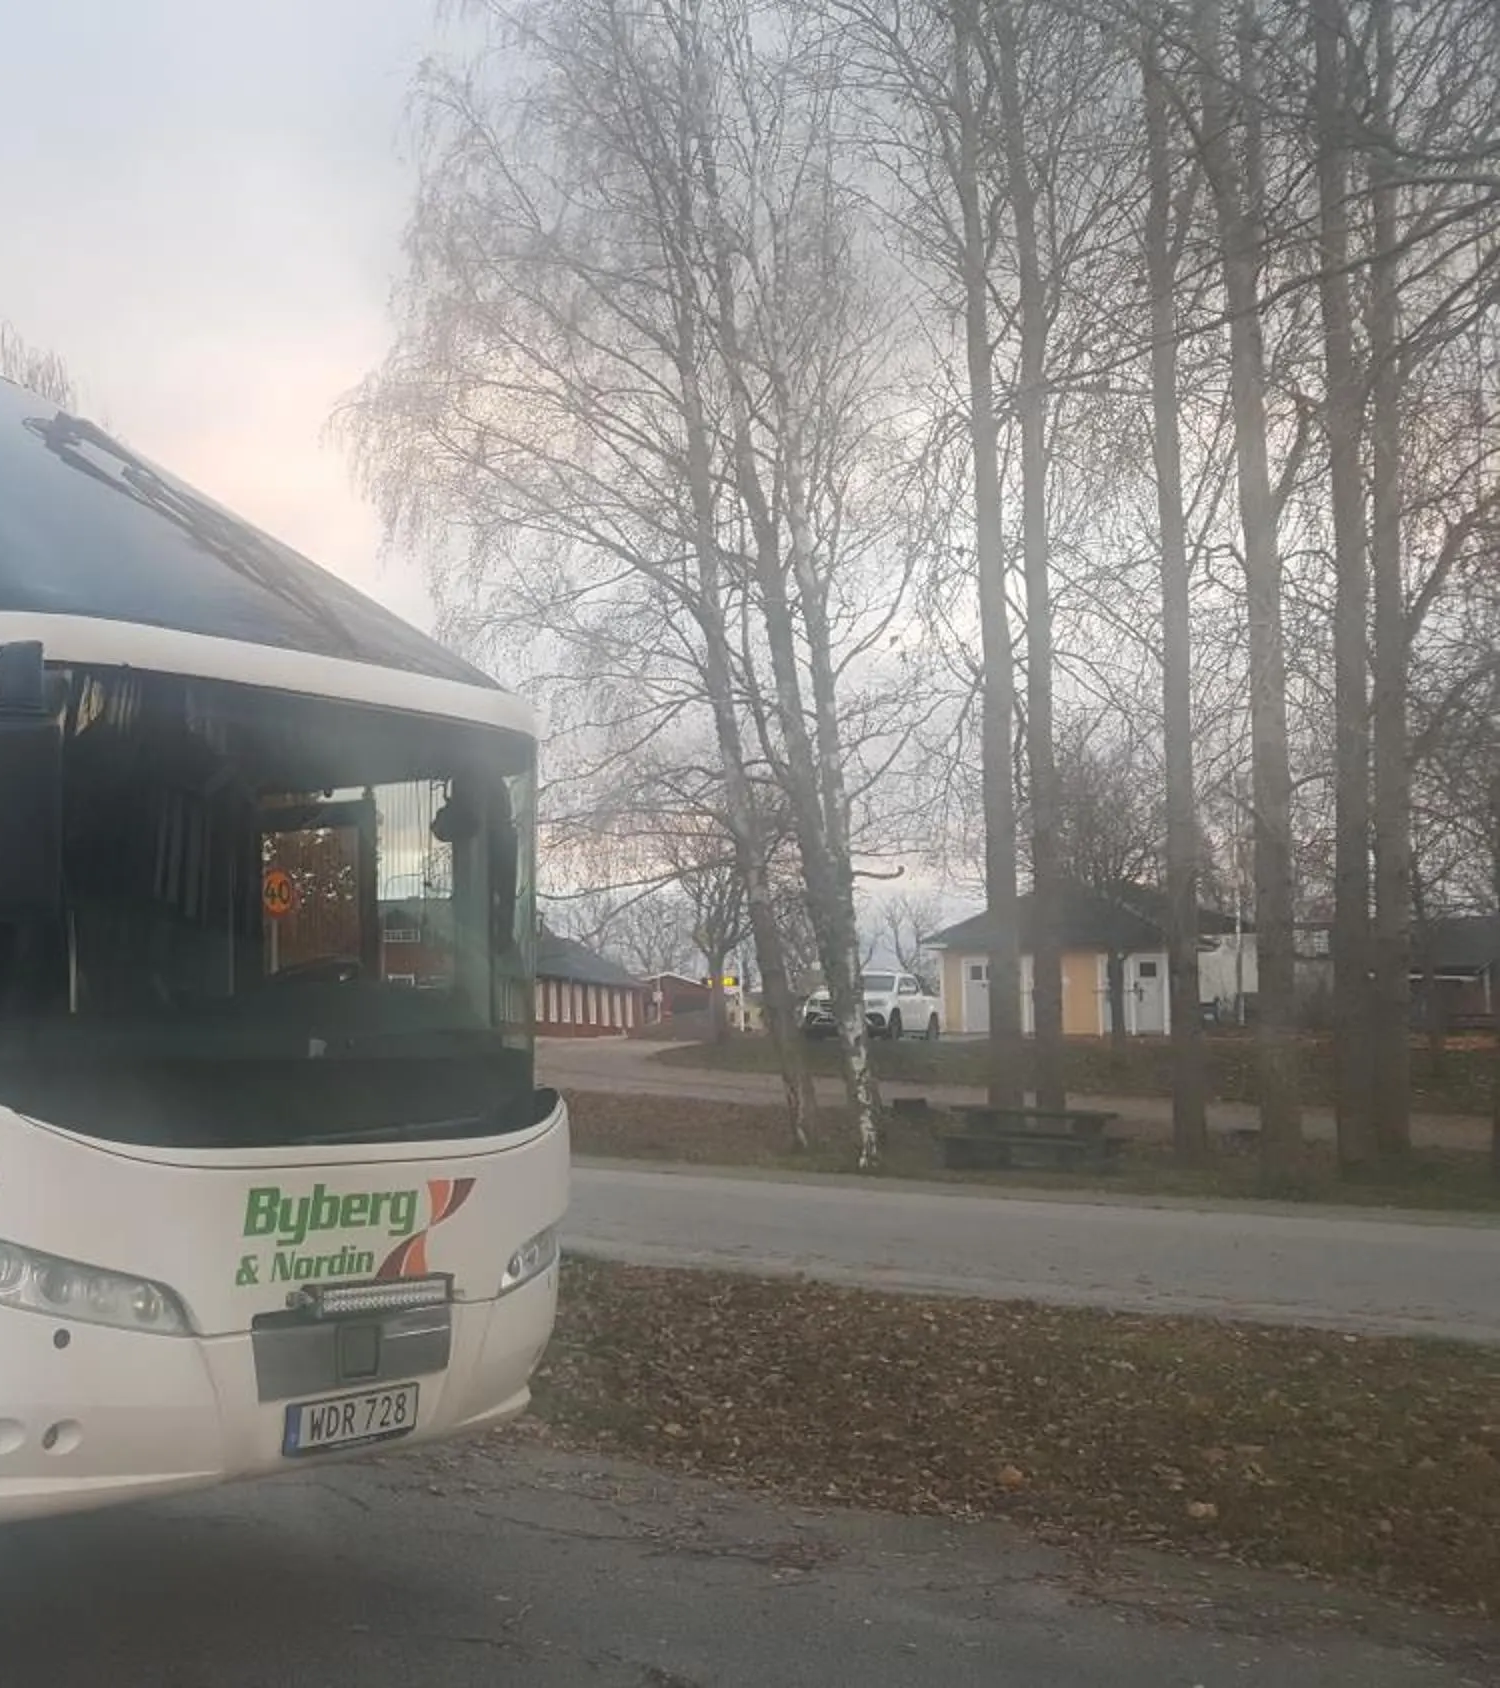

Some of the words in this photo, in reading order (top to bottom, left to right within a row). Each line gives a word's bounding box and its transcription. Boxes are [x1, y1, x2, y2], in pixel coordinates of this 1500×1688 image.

[264, 879, 290, 905] 40
[241, 1183, 419, 1247] Byberg
[235, 1254, 259, 1286] &
[269, 1245, 374, 1283] Nordin
[310, 1402, 357, 1441] WDR
[365, 1392, 407, 1431] 728
